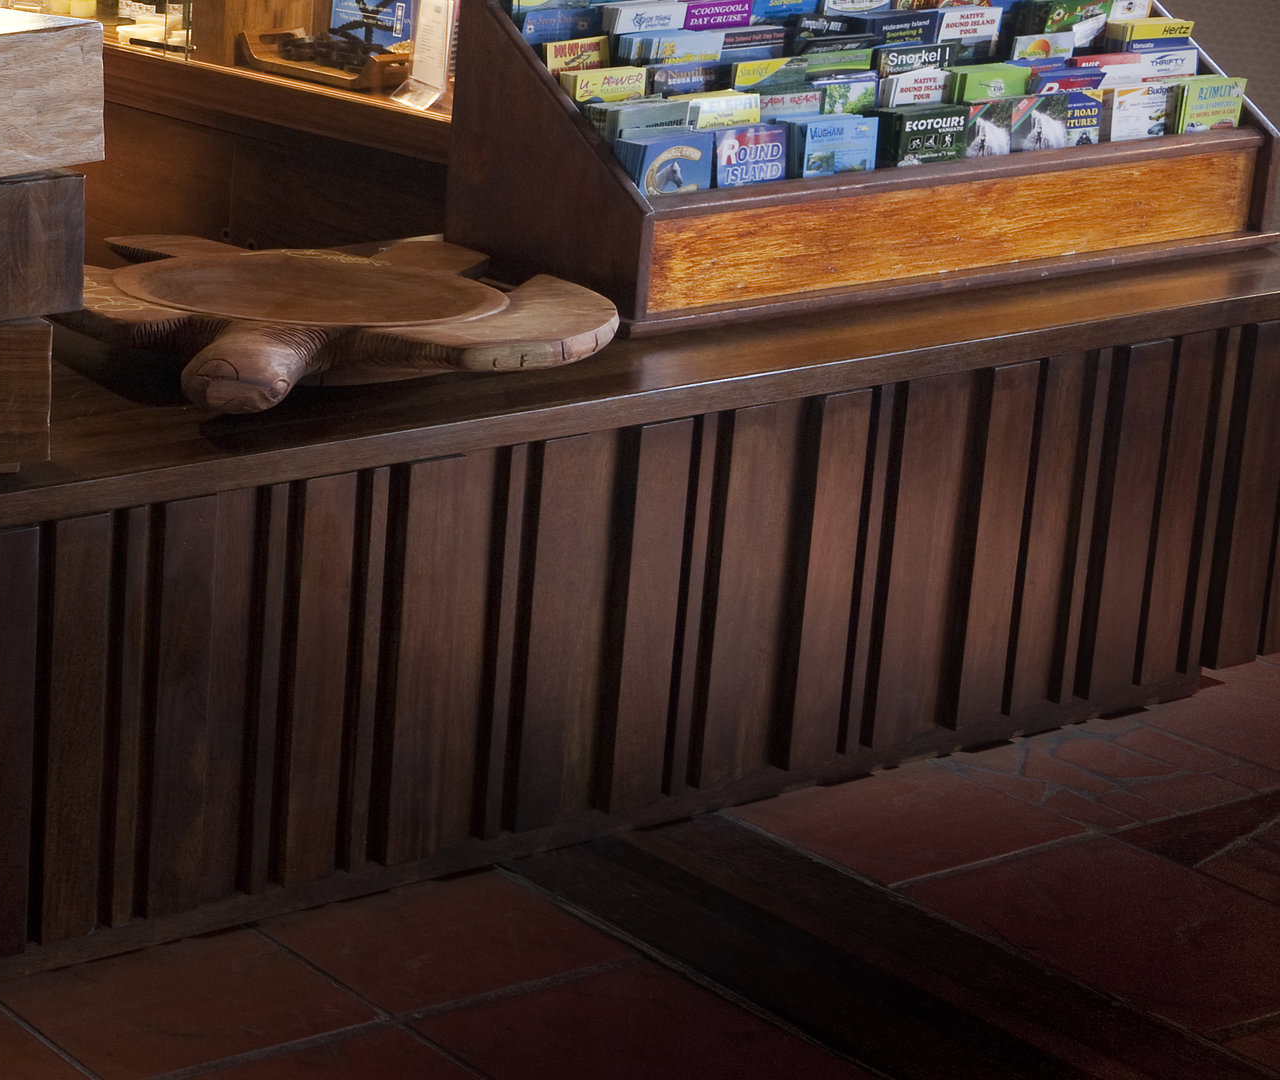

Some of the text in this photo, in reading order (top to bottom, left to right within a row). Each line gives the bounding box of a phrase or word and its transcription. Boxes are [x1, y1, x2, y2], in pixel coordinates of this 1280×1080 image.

[690, 16, 709, 26] DAY
[883, 19, 930, 32] Hideaway Island
[945, 21, 970, 29] ROUND
[1161, 25, 1190, 36] Hertz
[887, 48, 942, 66] Snorkel
[1150, 57, 1186, 67] THRIFTY
[667, 66, 715, 80] Nautilus
[738, 64, 769, 78] Snorkel
[667, 74, 716, 85] SCUBA DIVING
[913, 77, 938, 85] NATIVE
[899, 83, 947, 94] ROUND ISLAND
[1148, 86, 1174, 96] Budget
[1197, 84, 1233, 102] AZIMUT
[789, 92, 822, 105] BEACH
[913, 93, 931, 101] TOUR
[1073, 107, 1098, 117] ROAD
[905, 116, 965, 132] ECOTOURS
[810, 126, 845, 140] VAUGHANI
[721, 138, 784, 166] ROUND
[724, 161, 783, 185] ISLAND
